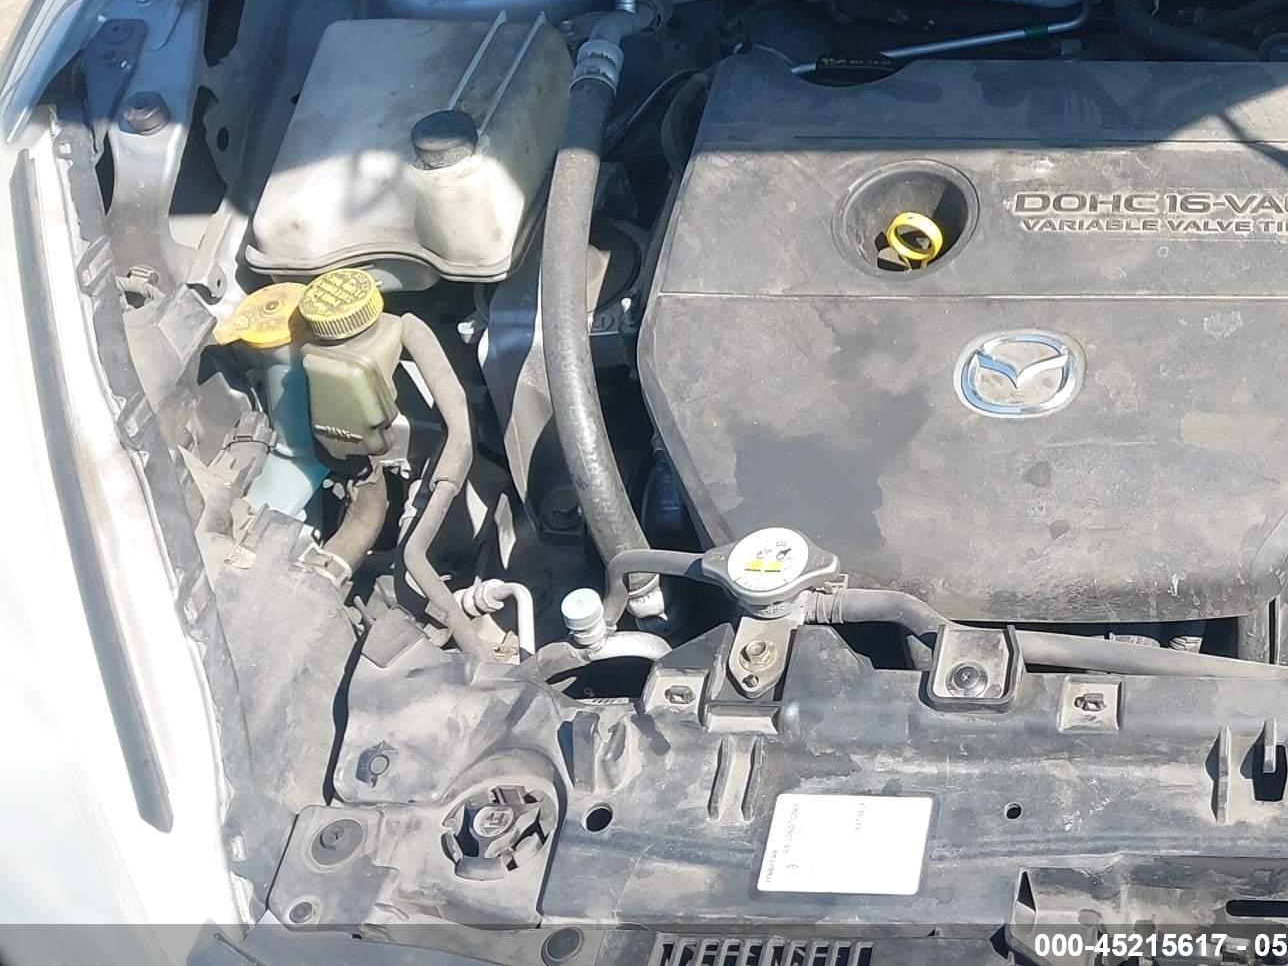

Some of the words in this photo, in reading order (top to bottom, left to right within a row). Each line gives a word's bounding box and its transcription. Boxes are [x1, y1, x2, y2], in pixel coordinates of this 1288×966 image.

[1014, 193, 1156, 214] DOHC
[1023, 219, 1159, 232] VARIABLE
[1166, 219, 1251, 233] VALVE
